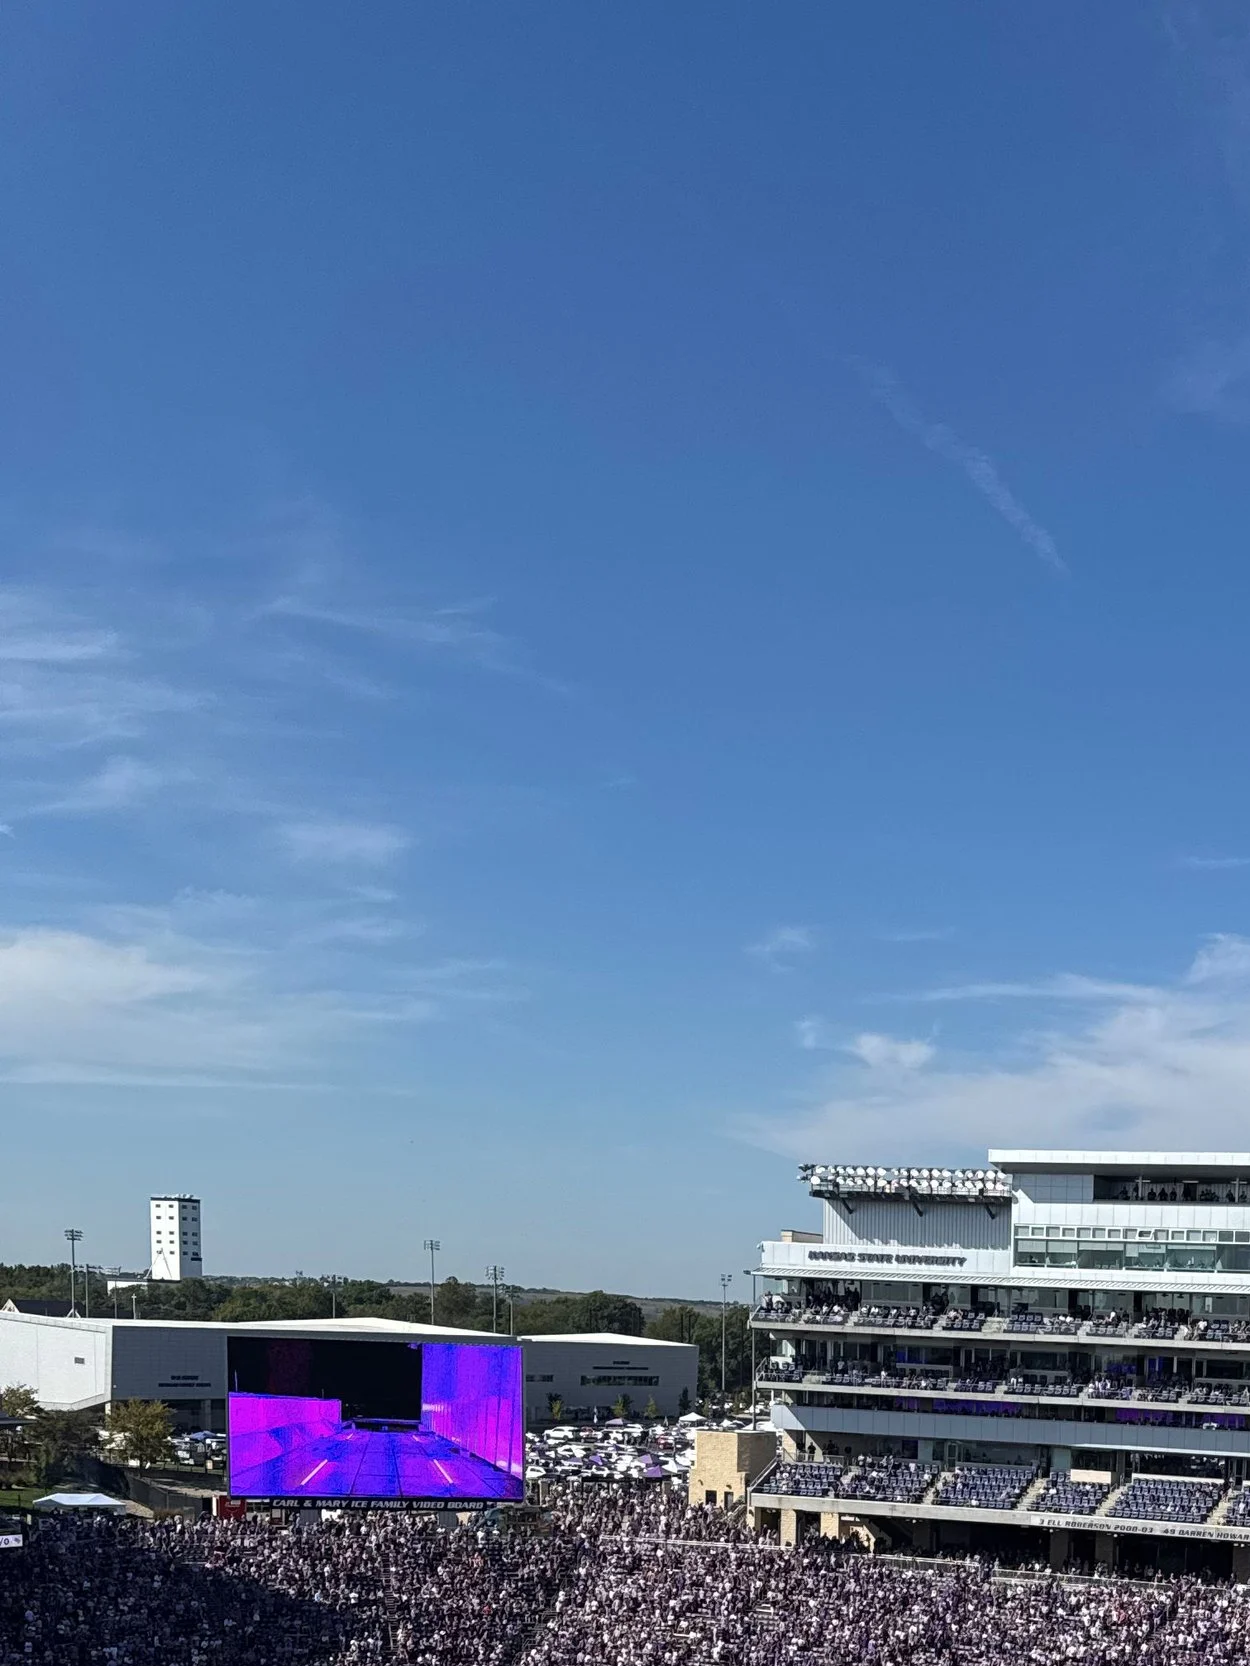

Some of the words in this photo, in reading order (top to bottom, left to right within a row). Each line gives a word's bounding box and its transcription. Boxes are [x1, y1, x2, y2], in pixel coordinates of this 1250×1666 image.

[808, 1250, 855, 1262] KANSAS
[857, 1252, 894, 1264] STATE
[895, 1254, 967, 1267] UNIVERSITY
[272, 1499, 300, 1508] CARL
[303, 1500, 310, 1508] &
[315, 1499, 349, 1509] MARY
[351, 1500, 367, 1509] ICE
[370, 1501, 409, 1510] FAMILY
[412, 1501, 445, 1510] VIDEO
[447, 1501, 484, 1510] BOARD
[1047, 1519, 1063, 1527] ELL
[1064, 1520, 1111, 1531] ROBERSON
[1178, 1528, 1214, 1539] DARREN
